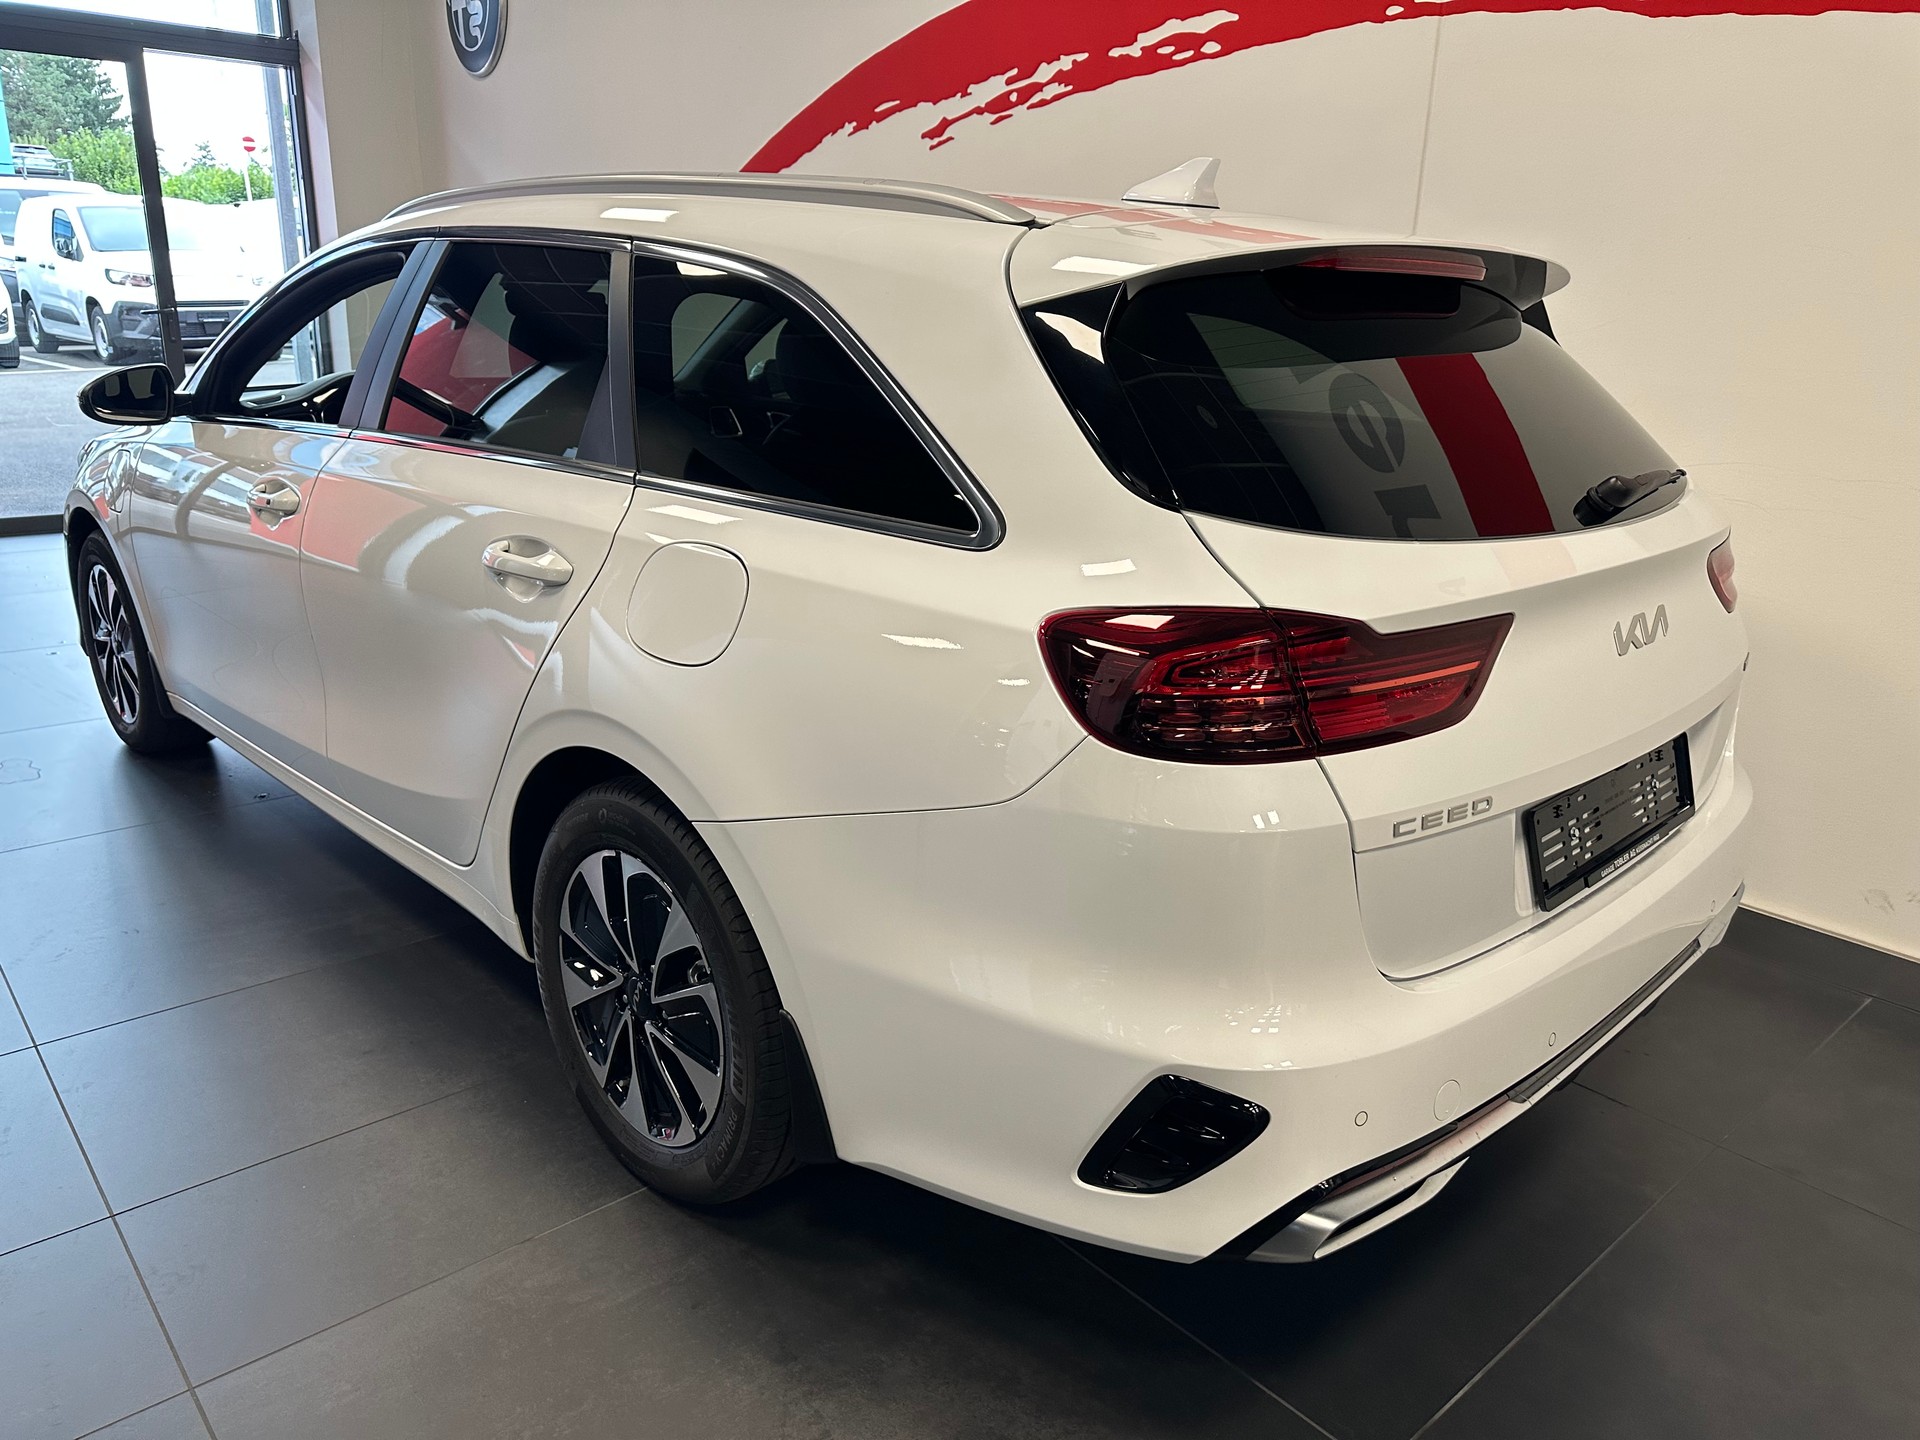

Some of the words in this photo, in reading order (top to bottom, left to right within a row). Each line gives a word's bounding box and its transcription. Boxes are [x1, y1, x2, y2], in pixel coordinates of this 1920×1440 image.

[1613, 604, 1669, 657] KIA
[1392, 796, 1493, 838] CEED
[1614, 853, 1629, 867] TOBLER
[1630, 849, 1636, 858] AG
[715, 1108, 738, 1166] PRIMACY
